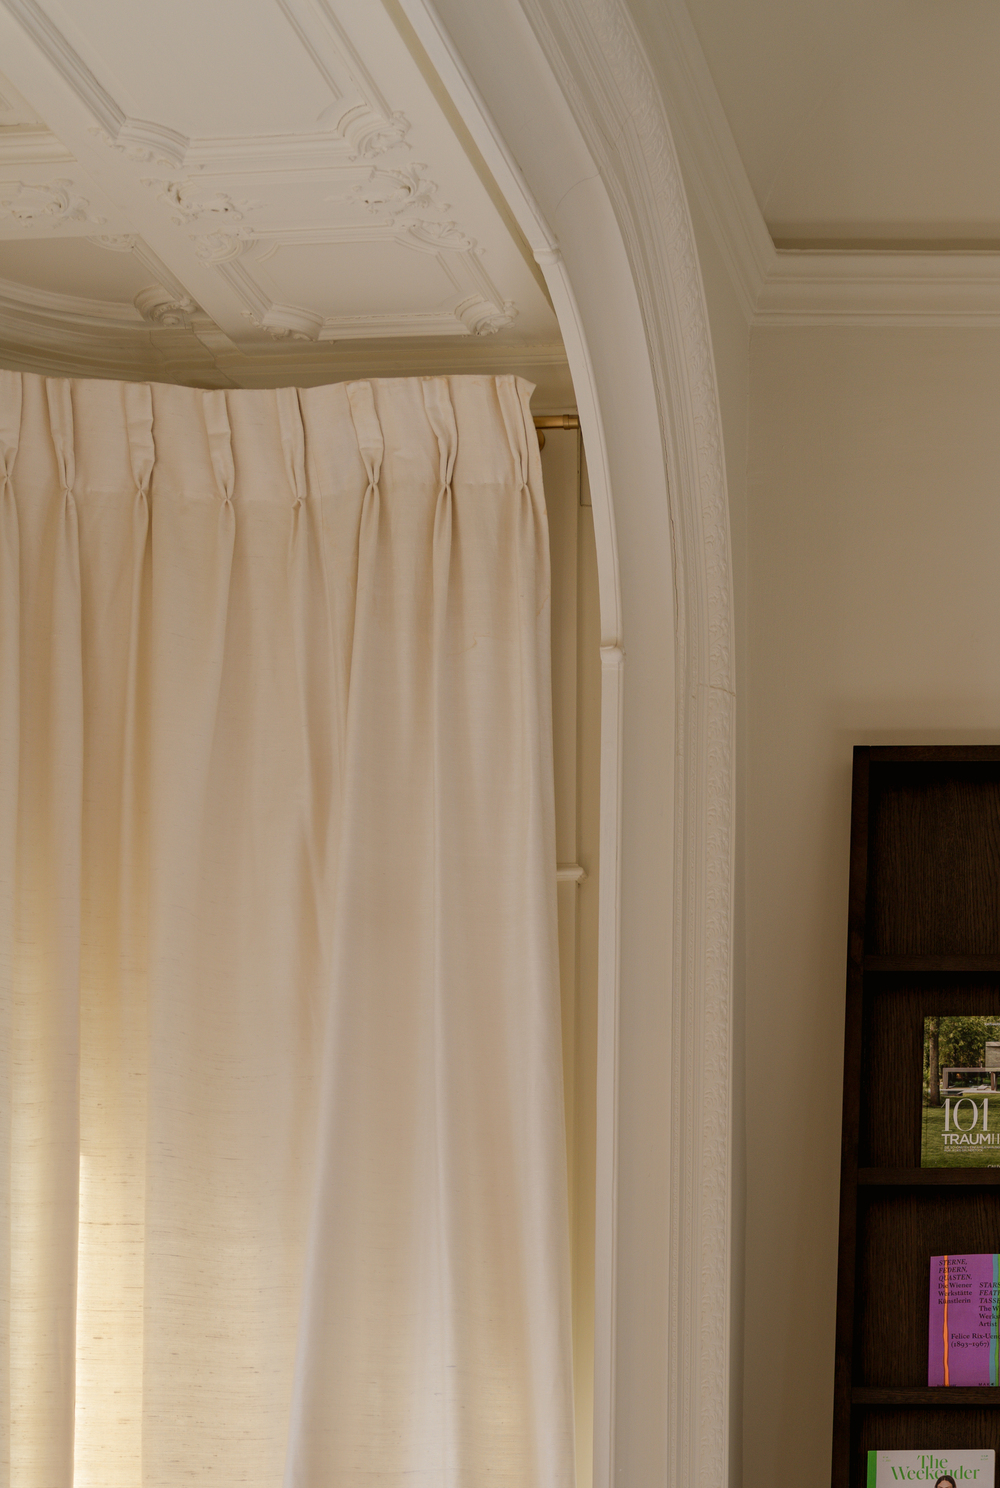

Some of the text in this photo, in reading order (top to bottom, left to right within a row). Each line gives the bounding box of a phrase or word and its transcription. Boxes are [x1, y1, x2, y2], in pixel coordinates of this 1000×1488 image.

[941, 1098, 990, 1132] 101
[917, 1455, 948, 1469] The
[891, 1466, 980, 1480] Weekender
